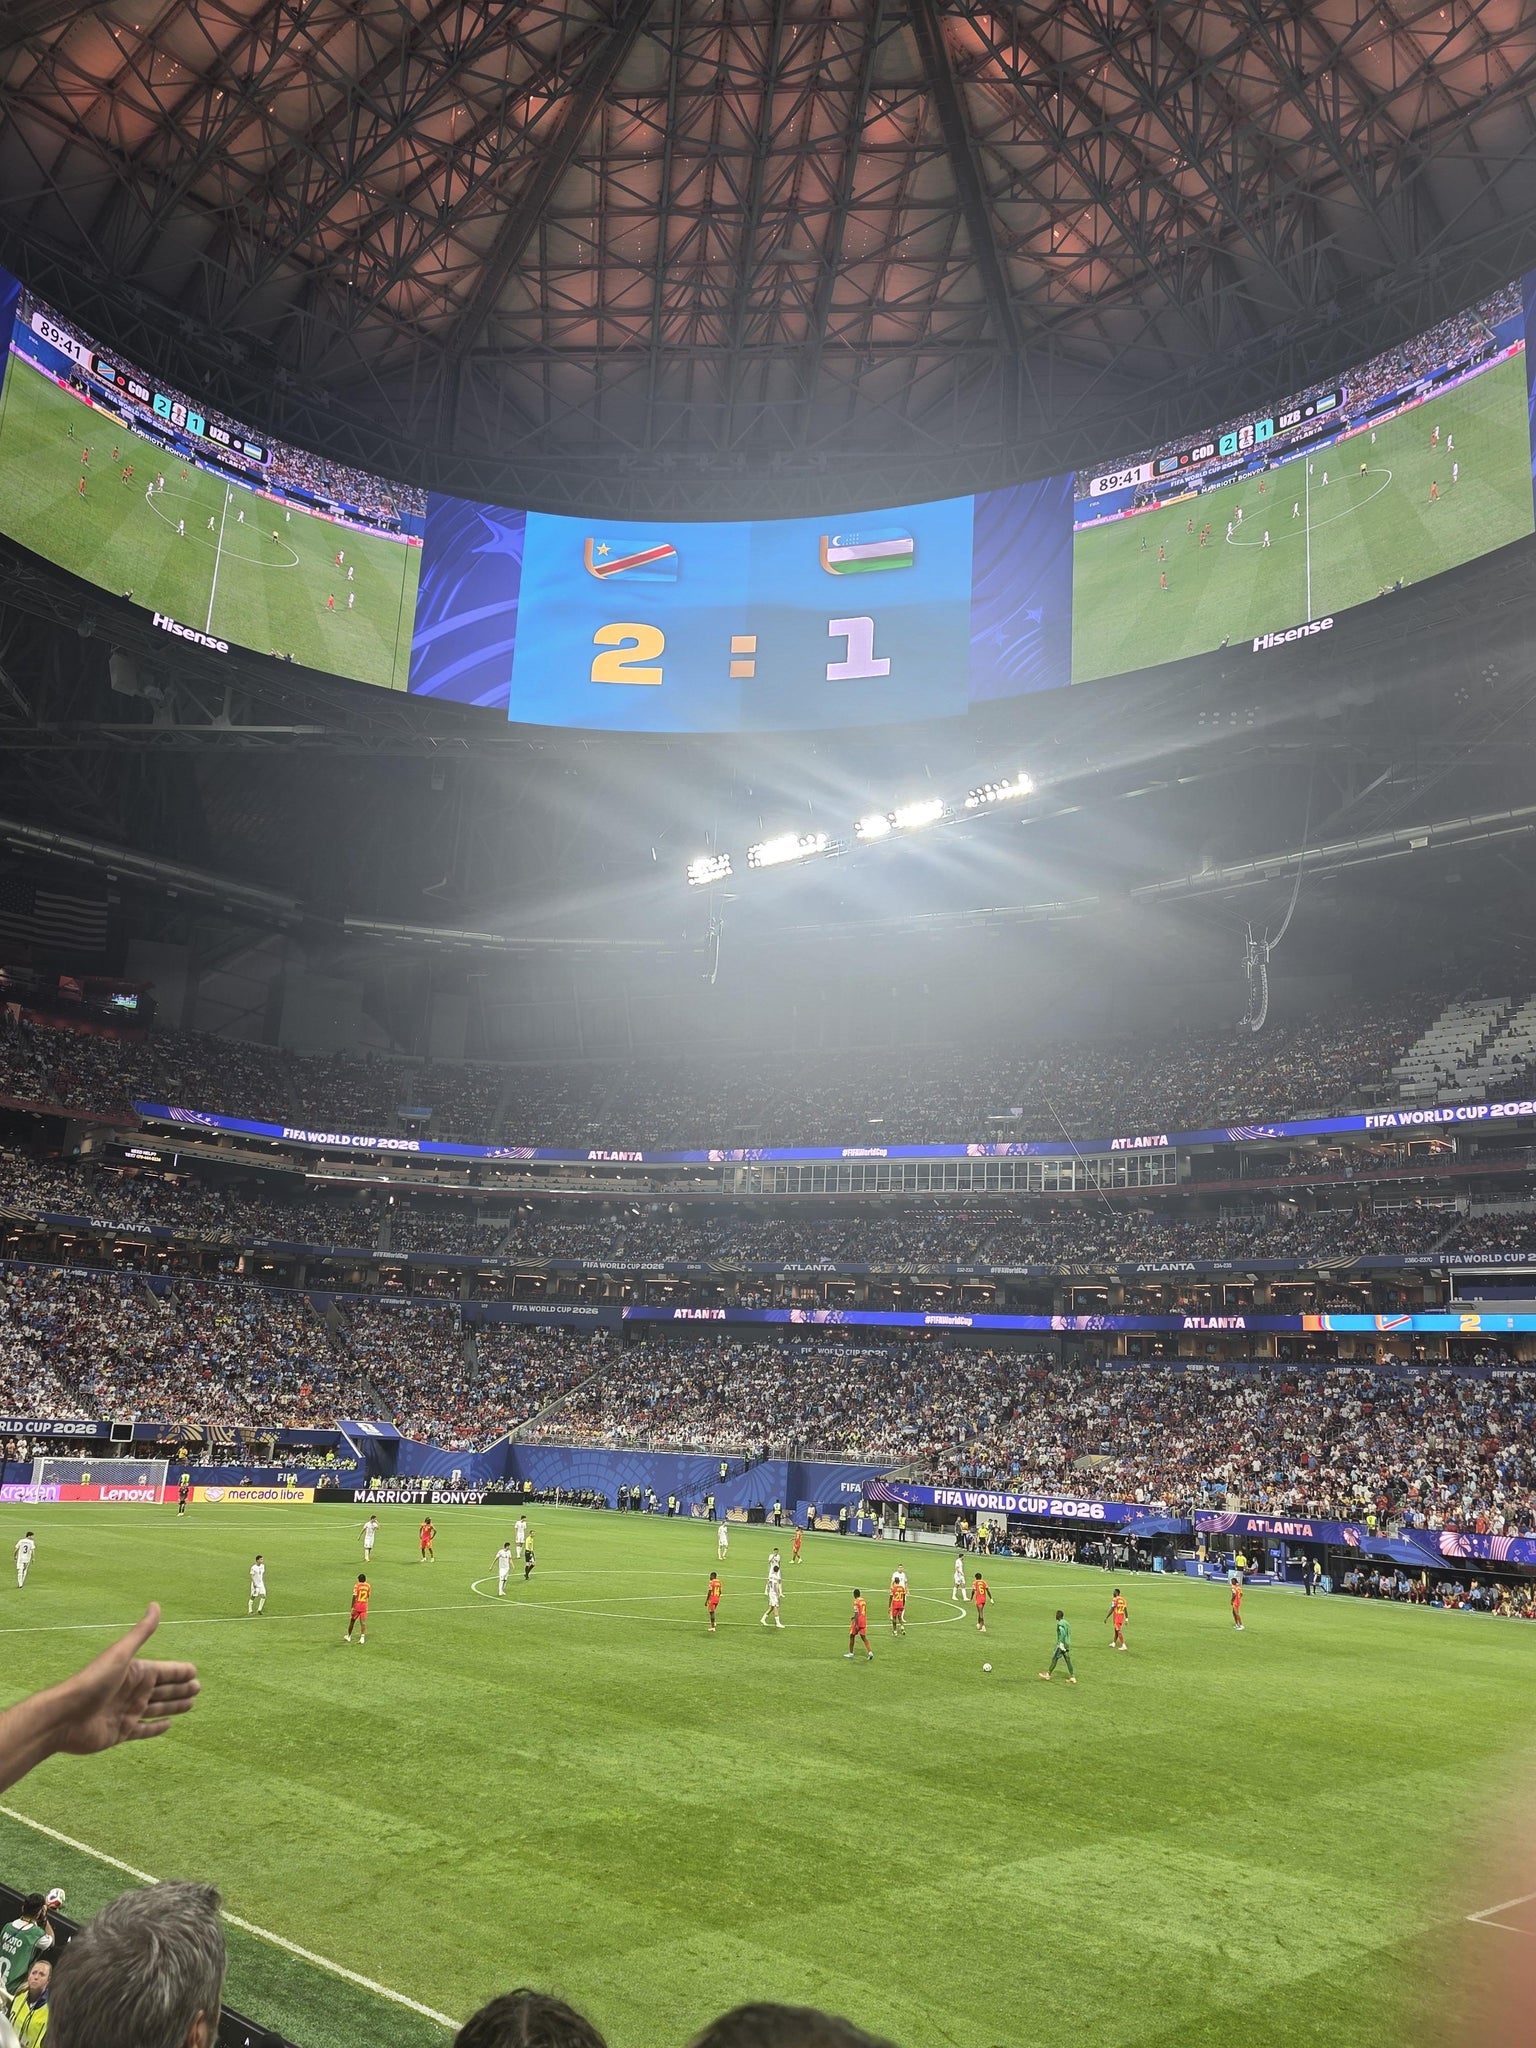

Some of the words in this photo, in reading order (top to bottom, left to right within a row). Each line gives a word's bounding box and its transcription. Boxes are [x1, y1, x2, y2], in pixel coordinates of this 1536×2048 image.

[40, 322, 80, 360] 89:41
[104, 392, 118, 404] FIFA
[118, 399, 140, 417] WORLD
[140, 413, 152, 424] CUP
[128, 380, 150, 402] COD
[158, 399, 166, 413] 2
[193, 418, 199, 430] 1
[210, 425, 230, 445] UZB
[1192, 444, 1214, 462] COD
[1224, 438, 1233, 451] 2
[1260, 424, 1267, 436] 1
[1280, 410, 1301, 428] UZB
[1290, 426, 1323, 444] ATLANTA
[216, 454, 247, 472] ATLANTA
[1100, 468, 1142, 492] 89:41
[1170, 478, 1186, 488] FIFA
[1185, 470, 1208, 484] WORLD
[1208, 465, 1222, 475] CUP
[152, 612, 229, 654] Hisense
[1252, 617, 1334, 653] Hisense
[590, 622, 665, 686] 2
[729, 635, 757, 678] :
[826, 616, 890, 681] 1
[1365, 1114, 1398, 1128] FIFA
[1398, 1109, 1454, 1124] WORLD
[1456, 1105, 1488, 1120] CUP
[1489, 1101, 1536, 1117] 202
[282, 1127, 306, 1142] FIFA
[308, 1131, 350, 1146] WORLD
[352, 1136, 377, 1147] CUP
[377, 1138, 420, 1150] 2026
[1110, 1134, 1169, 1150] ATLANTA
[588, 1150, 643, 1162] ATLANTA
[92, 1219, 152, 1233] ATLANTA
[600, 1262, 626, 1270] WORLD
[1136, 1262, 1196, 1272] ATLANTA
[1440, 1255, 1462, 1264] FIFA
[1463, 1254, 1501, 1263] WORLD
[1502, 1253, 1526, 1262] CUP
[783, 1264, 836, 1272] ATLANTA
[512, 1304, 528, 1312] FIFA
[528, 1305, 556, 1313] WORLD
[556, 1306, 572, 1314] CUP
[674, 1308, 726, 1320] ATLANTA
[1184, 1317, 1246, 1328] ATLANTA
[1460, 1314, 1482, 1332] 2
[25, 1422, 52, 1433] CUP
[52, 1423, 98, 1434] 2026
[1, 1485, 56, 1500] kraken
[228, 1489, 278, 1500] mercado
[279, 1488, 305, 1500] libre
[840, 1482, 862, 1493] FIFA
[354, 1490, 428, 1504] MARRIOTT
[432, 1492, 486, 1504] BONVOY
[934, 1490, 963, 1507] FIFA
[964, 1492, 1017, 1511] WORLD
[1018, 1496, 1048, 1514] CUP
[1050, 1501, 1105, 1518] 2026
[1246, 1520, 1314, 1537] ATLANTA
